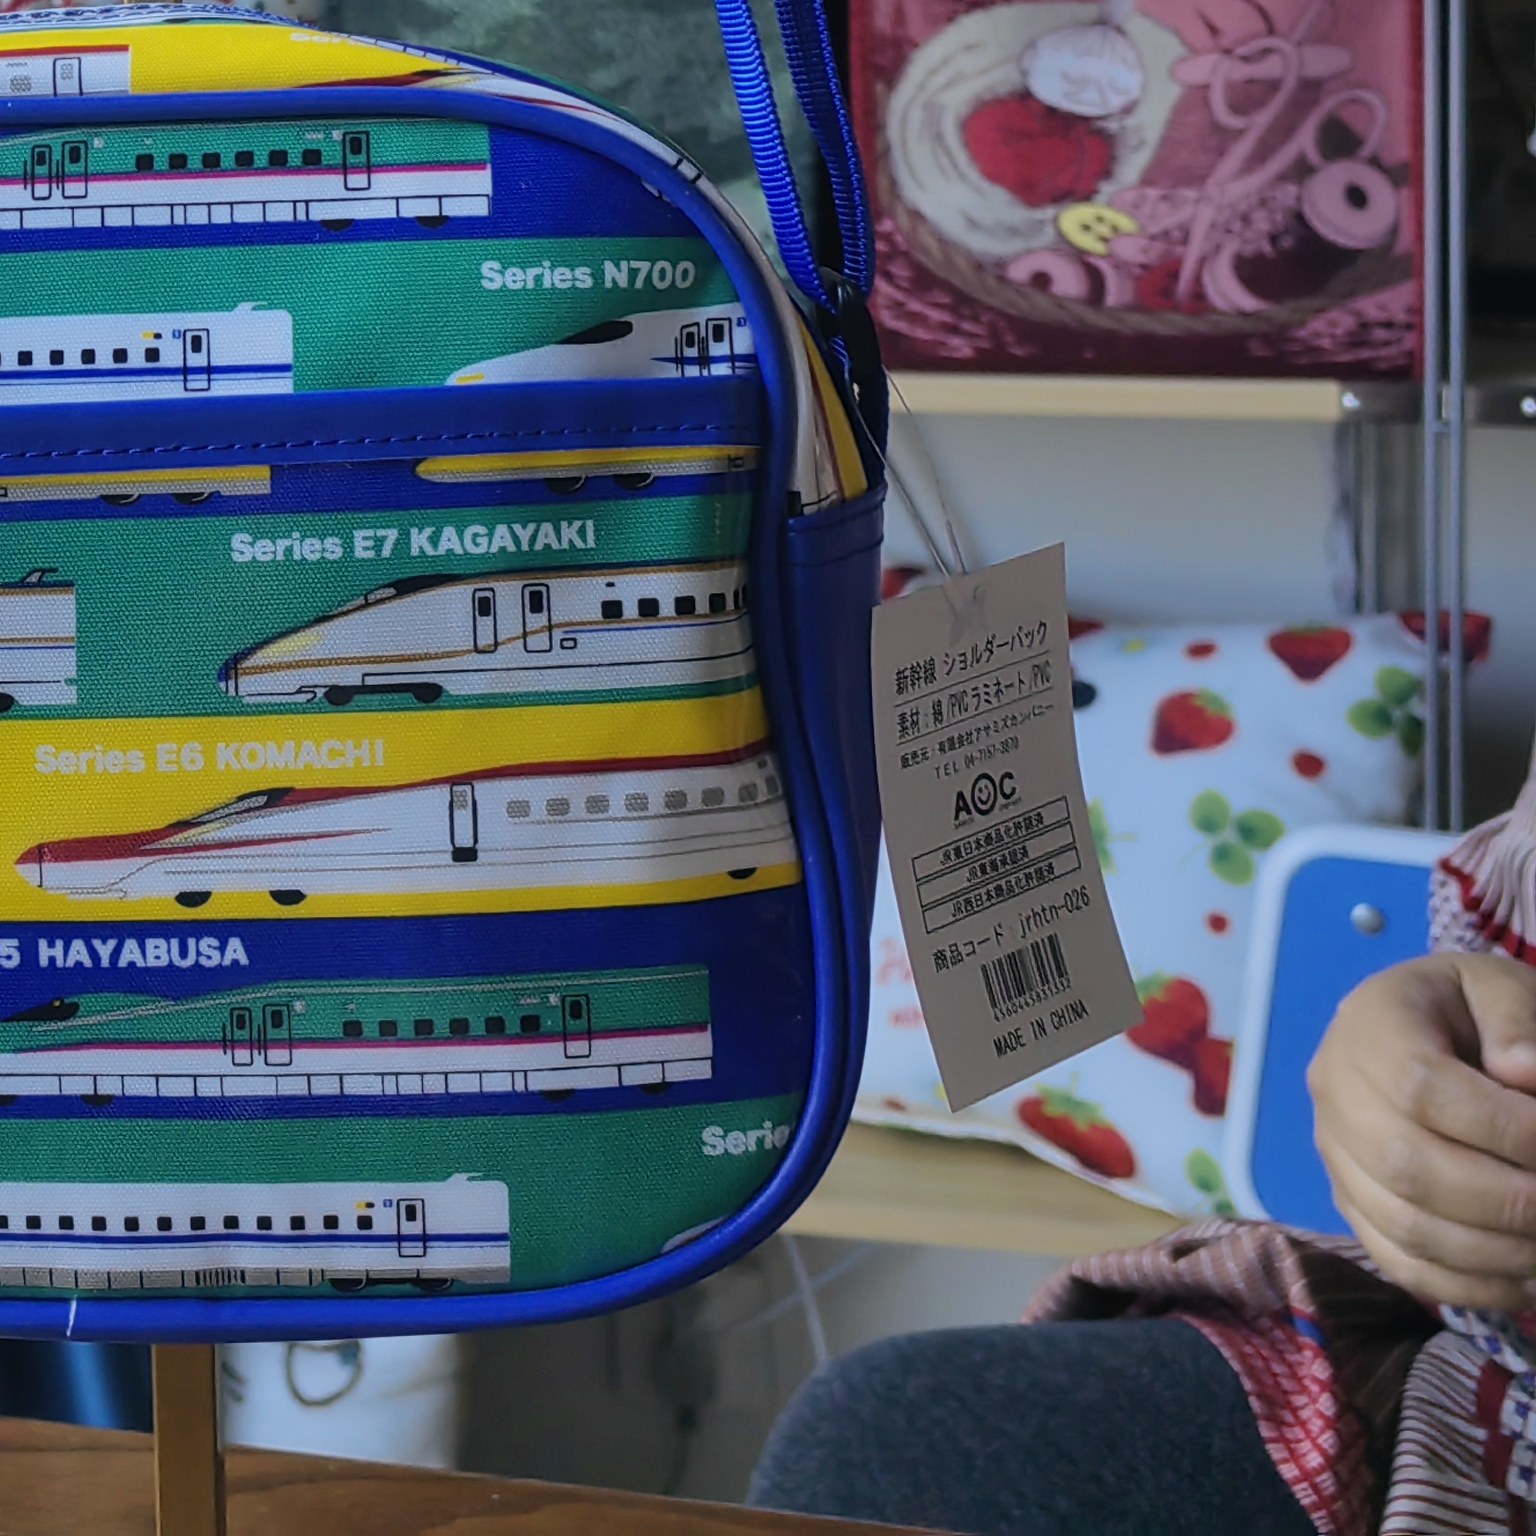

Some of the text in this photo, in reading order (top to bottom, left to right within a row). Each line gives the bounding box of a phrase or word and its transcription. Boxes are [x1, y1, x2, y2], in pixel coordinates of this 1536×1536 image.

[480, 260, 696, 290] Series N700
[230, 519, 596, 563] Series E7 KAGAYAKI
[895, 655, 938, 696] 新幹線
[35, 739, 385, 775] Series E6 KOMACHI
[38, 936, 250, 969] HAYABUSA
[992, 999, 1089, 1058] MADE IN CHINA
